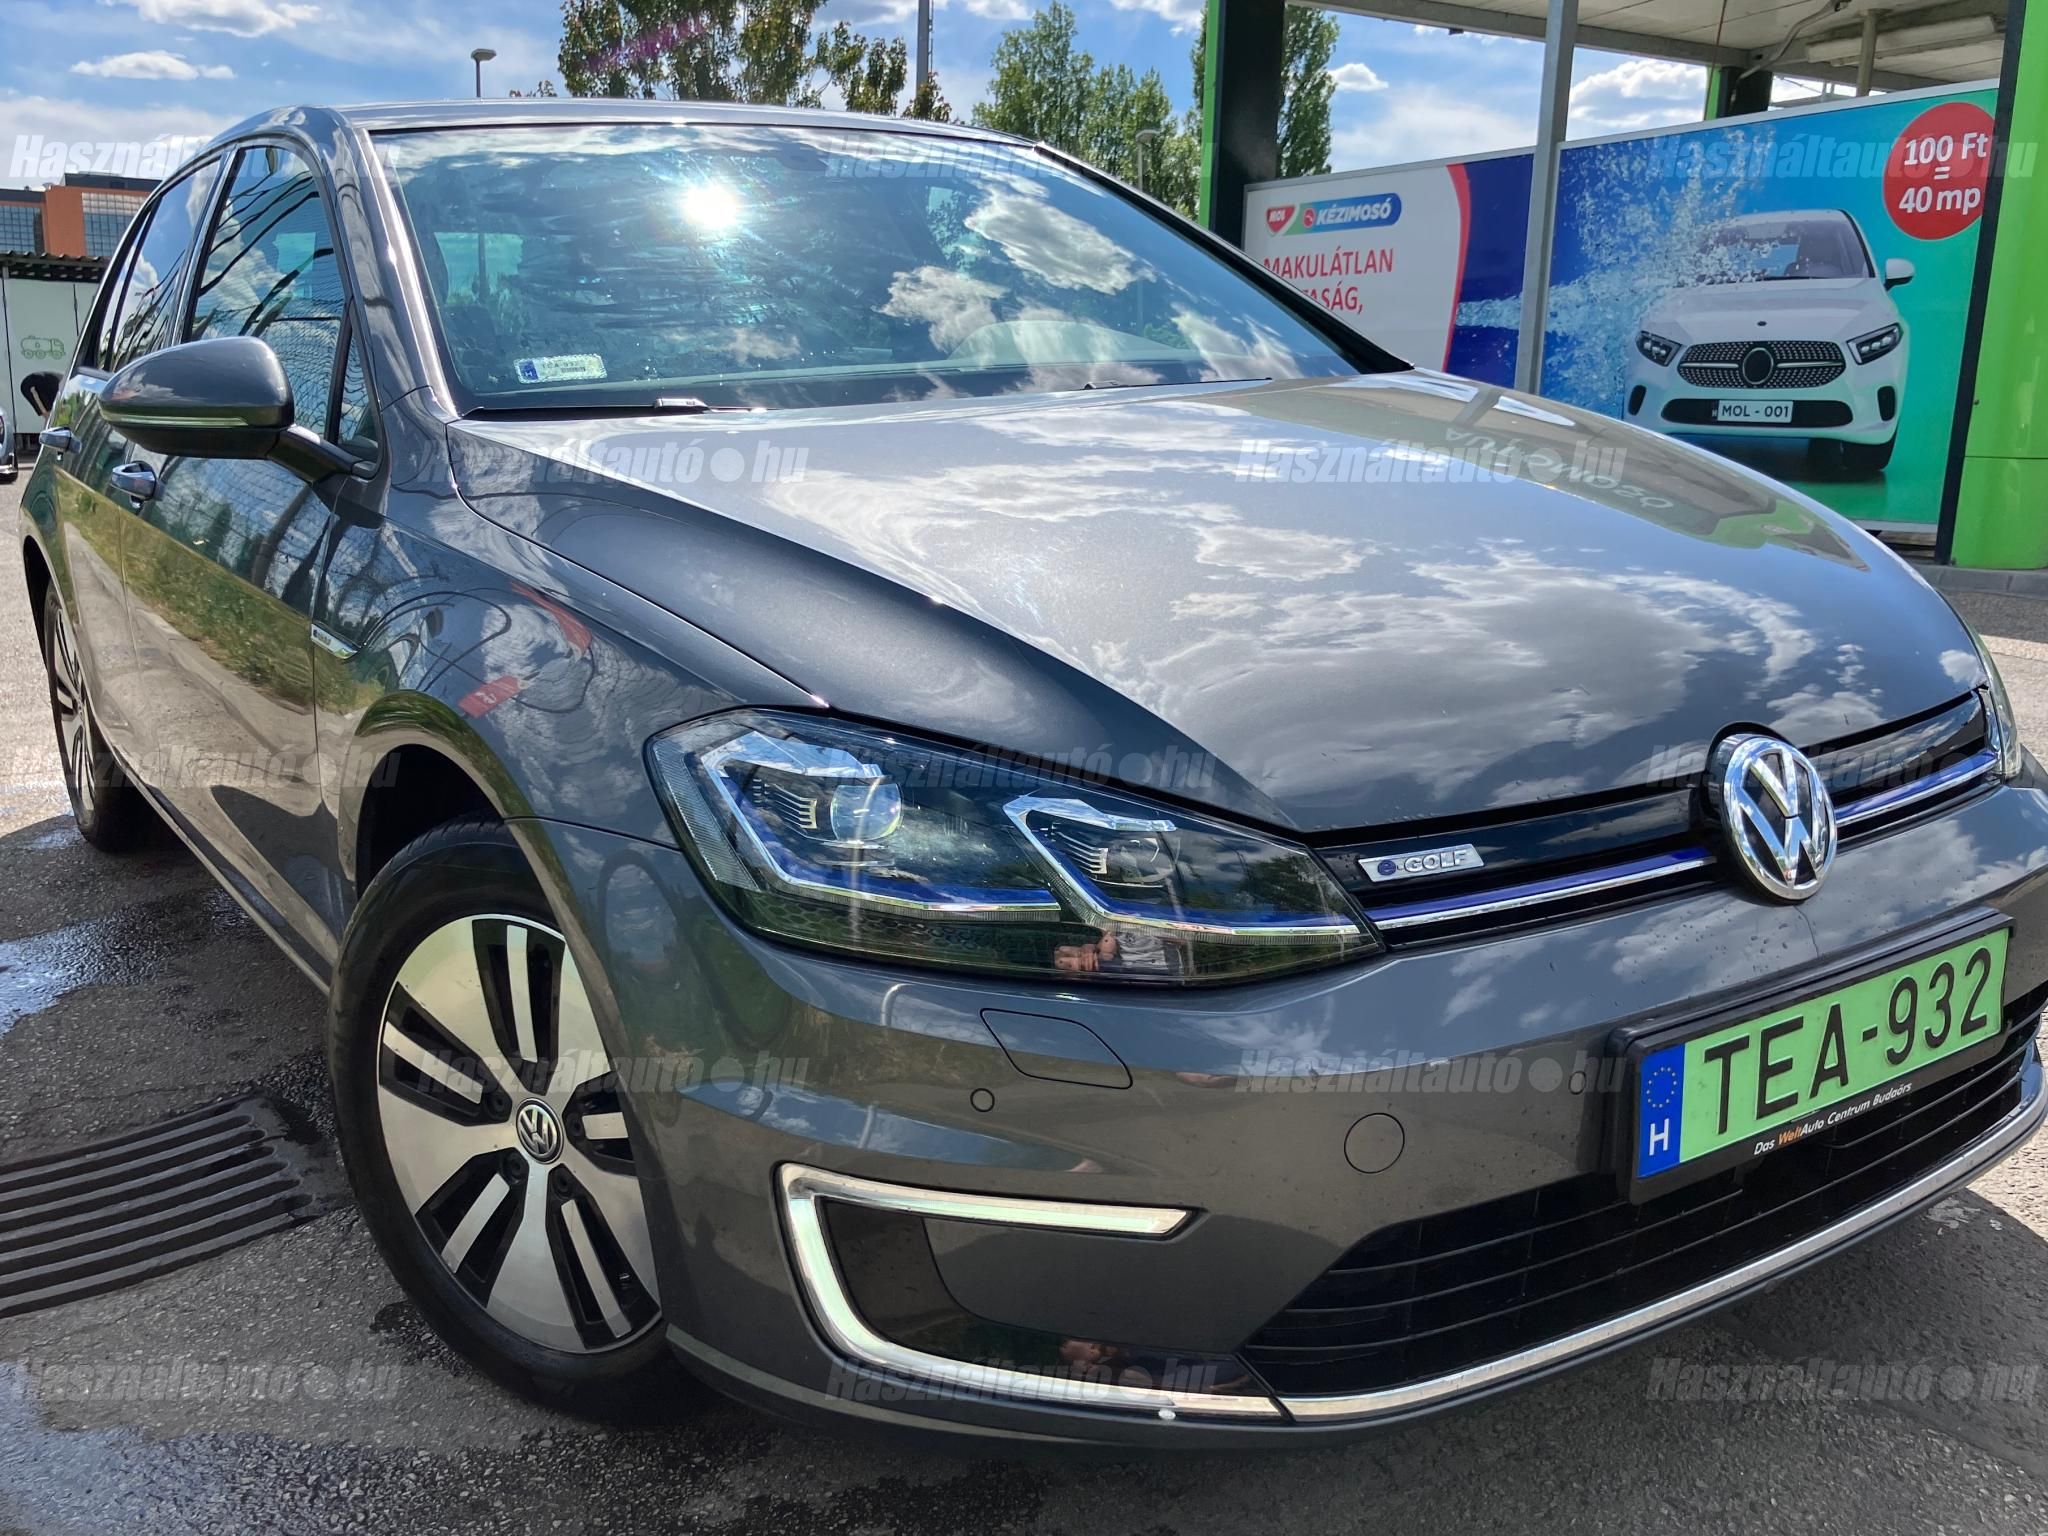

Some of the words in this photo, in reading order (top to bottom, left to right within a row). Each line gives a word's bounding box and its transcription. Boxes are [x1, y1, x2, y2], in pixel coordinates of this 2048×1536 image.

[1904, 135, 1953, 166] 100
[1961, 132, 1988, 159] Ft
[1316, 198, 1393, 226] KÉZIMOSÓ
[1899, 186, 1932, 213] 40
[1936, 186, 1981, 215] mp
[1703, 947, 1992, 1135] TEA-932
[1648, 1119, 1670, 1156] H
[1754, 1138, 1775, 1155] Das
[1827, 1103, 1871, 1125] Centrum
